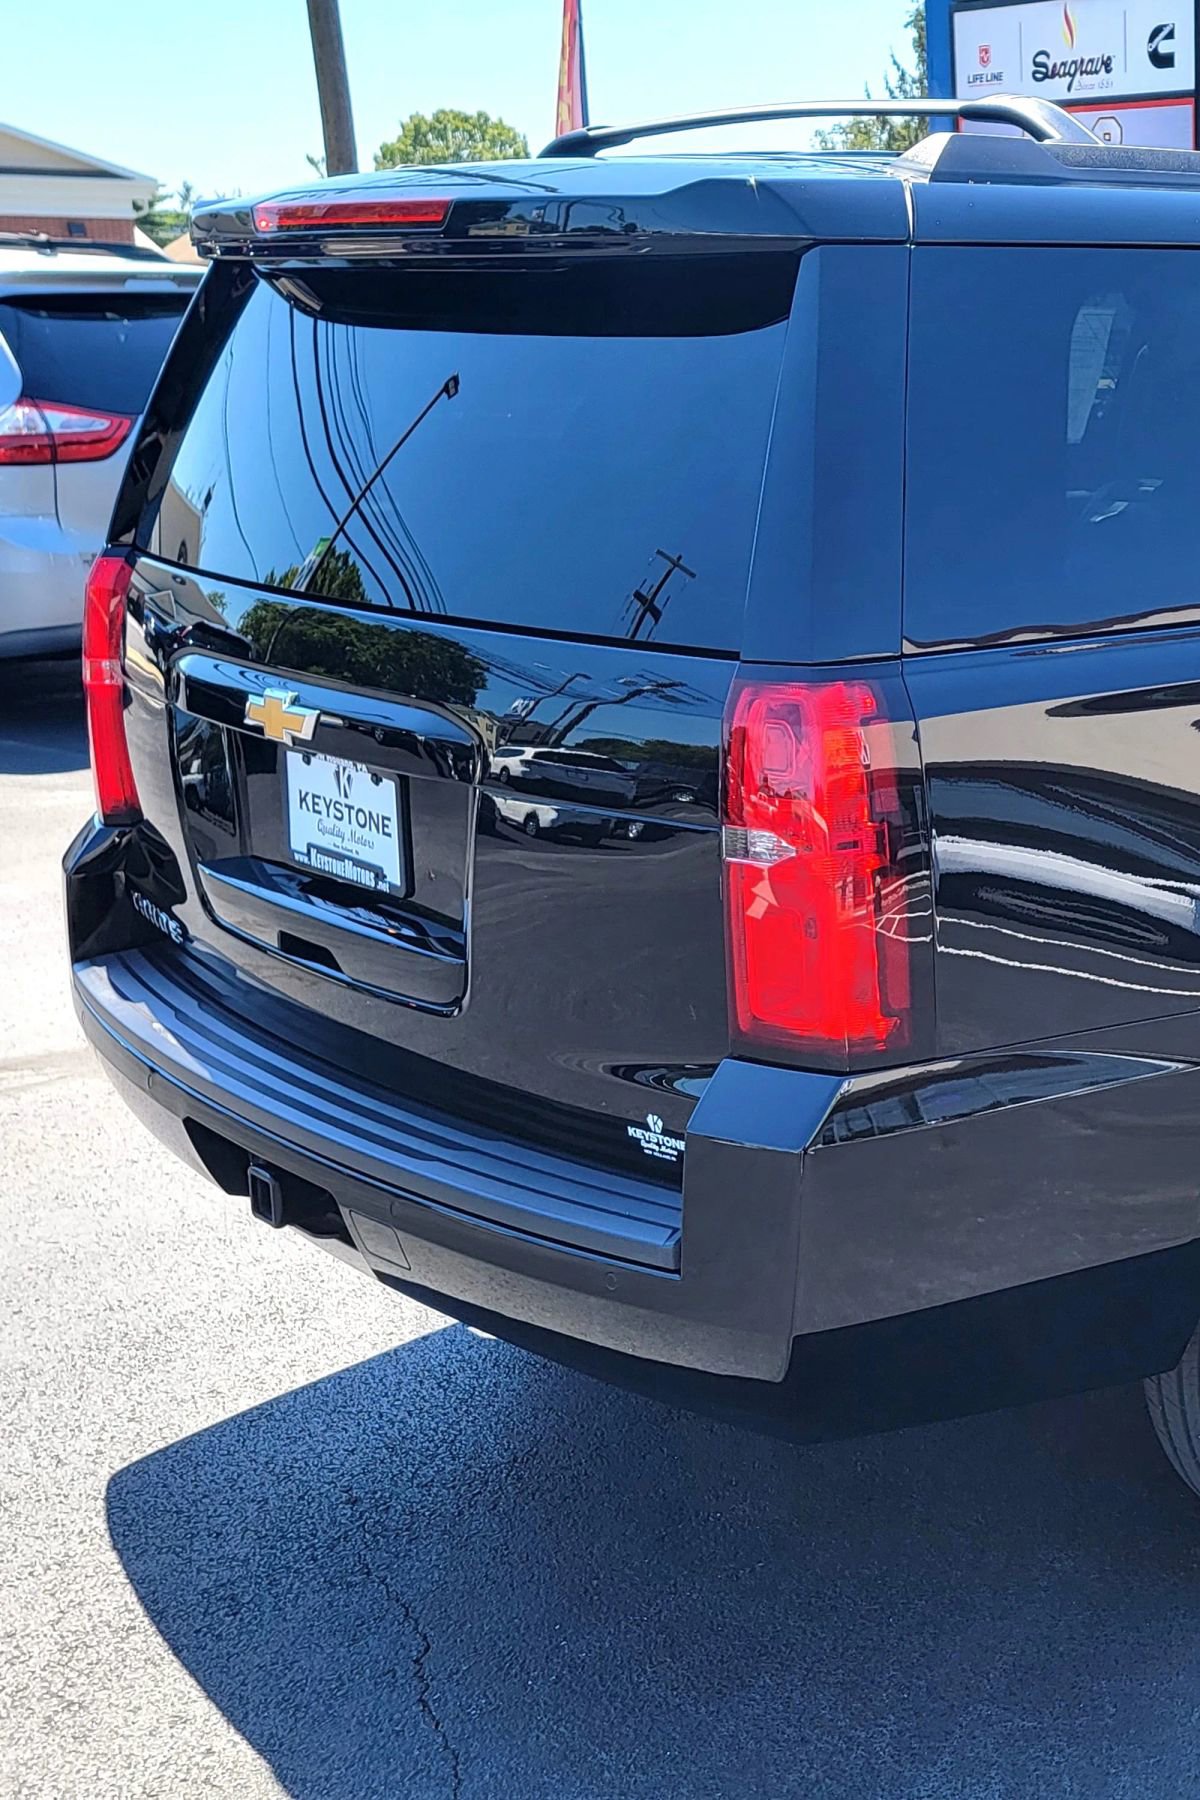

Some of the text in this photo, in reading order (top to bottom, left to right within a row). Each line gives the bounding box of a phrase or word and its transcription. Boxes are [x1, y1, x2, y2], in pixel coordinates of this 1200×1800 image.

[967, 72, 1004, 84] LIFE LINE
[1032, 50, 1113, 93] Seagrave
[298, 788, 392, 838] KEYSTONE
[317, 818, 346, 843] Quality
[347, 828, 375, 850] Motors
[627, 1125, 686, 1151] KEYSTONE
